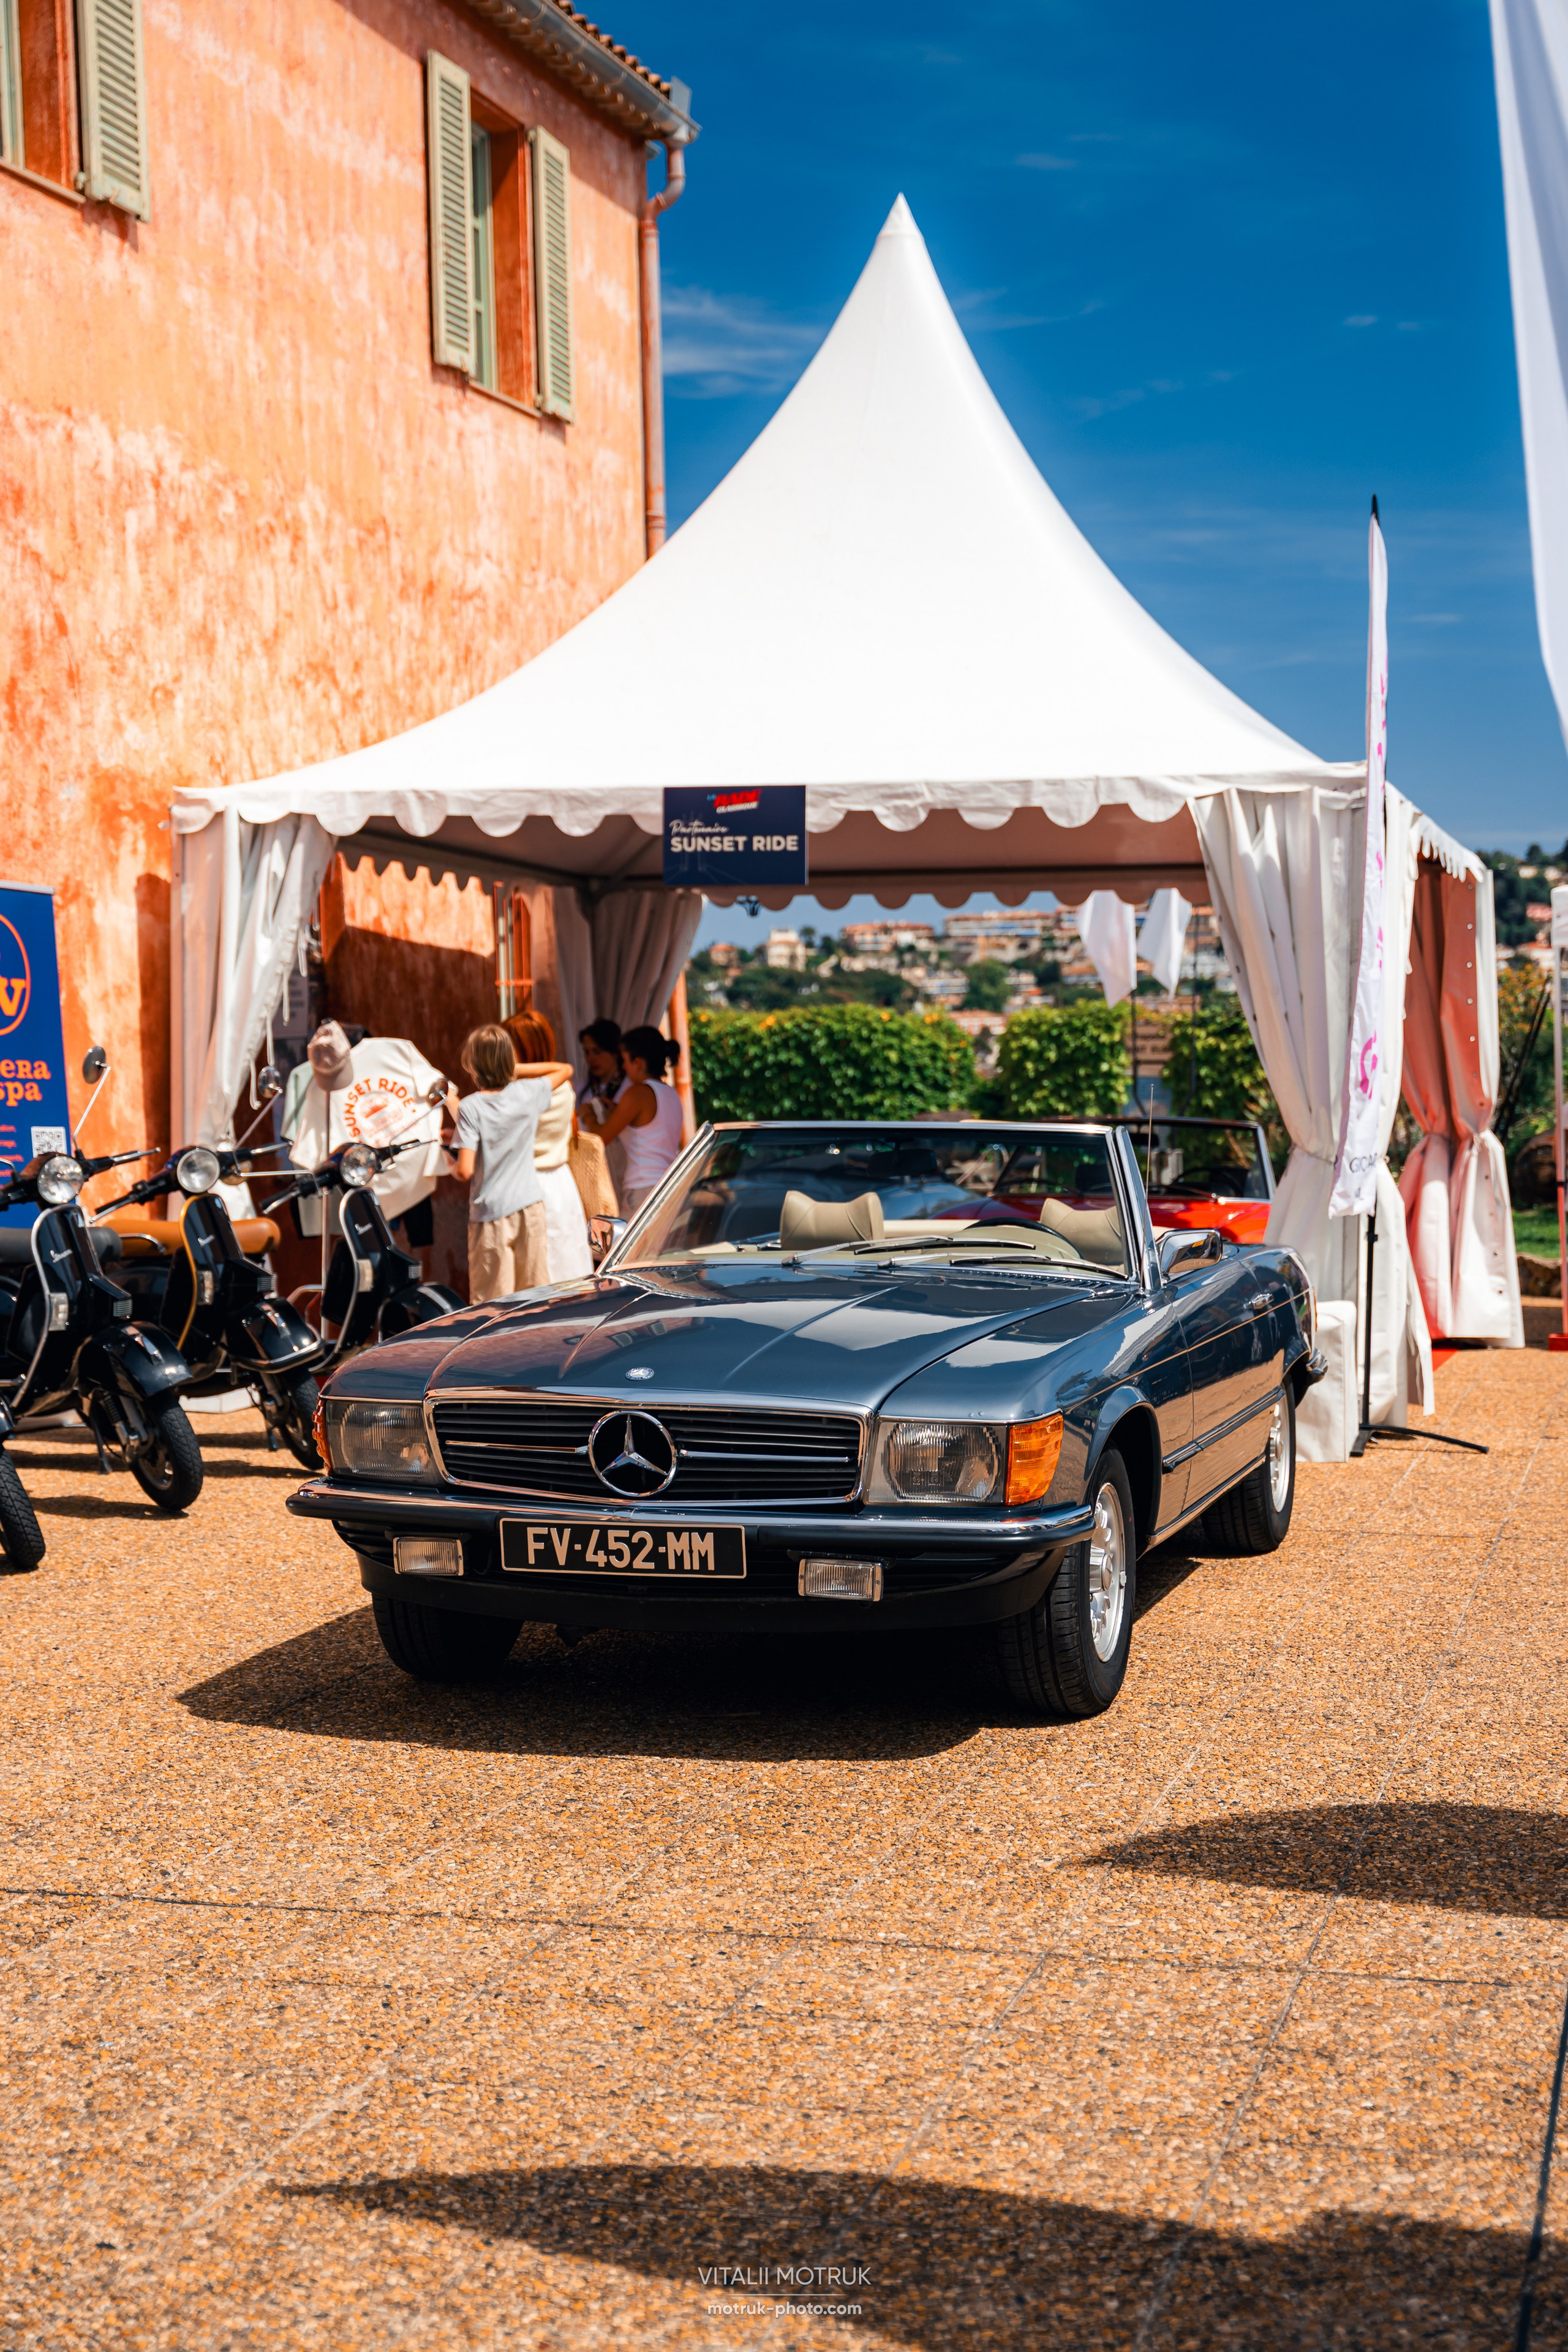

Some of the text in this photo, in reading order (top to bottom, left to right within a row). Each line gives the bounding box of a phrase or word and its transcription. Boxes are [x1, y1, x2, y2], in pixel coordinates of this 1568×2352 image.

[671, 835, 799, 853] SUNSET RIDE
[344, 1079, 372, 1137] SUNSET
[379, 1078, 416, 1107] RIDE
[527, 1526, 715, 1570] FV-452-MM
